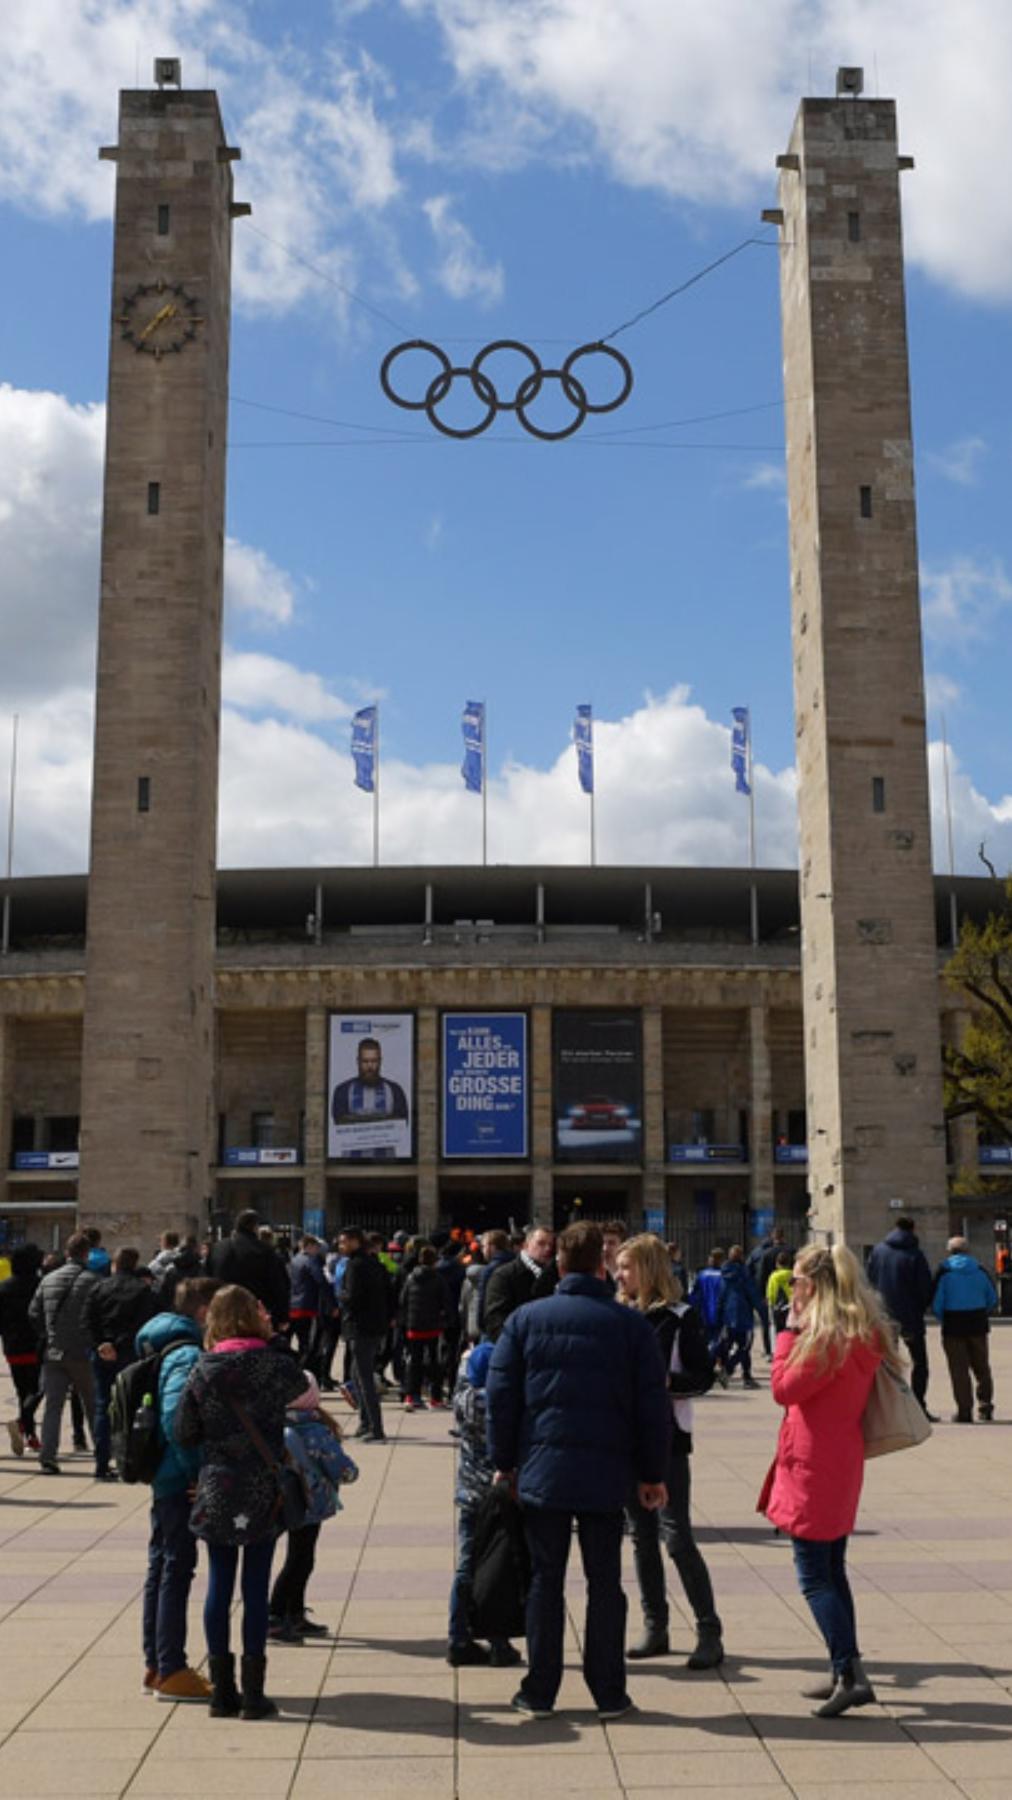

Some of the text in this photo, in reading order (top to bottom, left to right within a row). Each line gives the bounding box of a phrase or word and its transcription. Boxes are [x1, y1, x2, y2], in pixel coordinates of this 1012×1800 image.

[458, 1035, 502, 1050] ALLES
[462, 1051, 519, 1068] JEDER
[449, 1076, 521, 1094] GROSSE
[456, 1096, 493, 1111] DING
